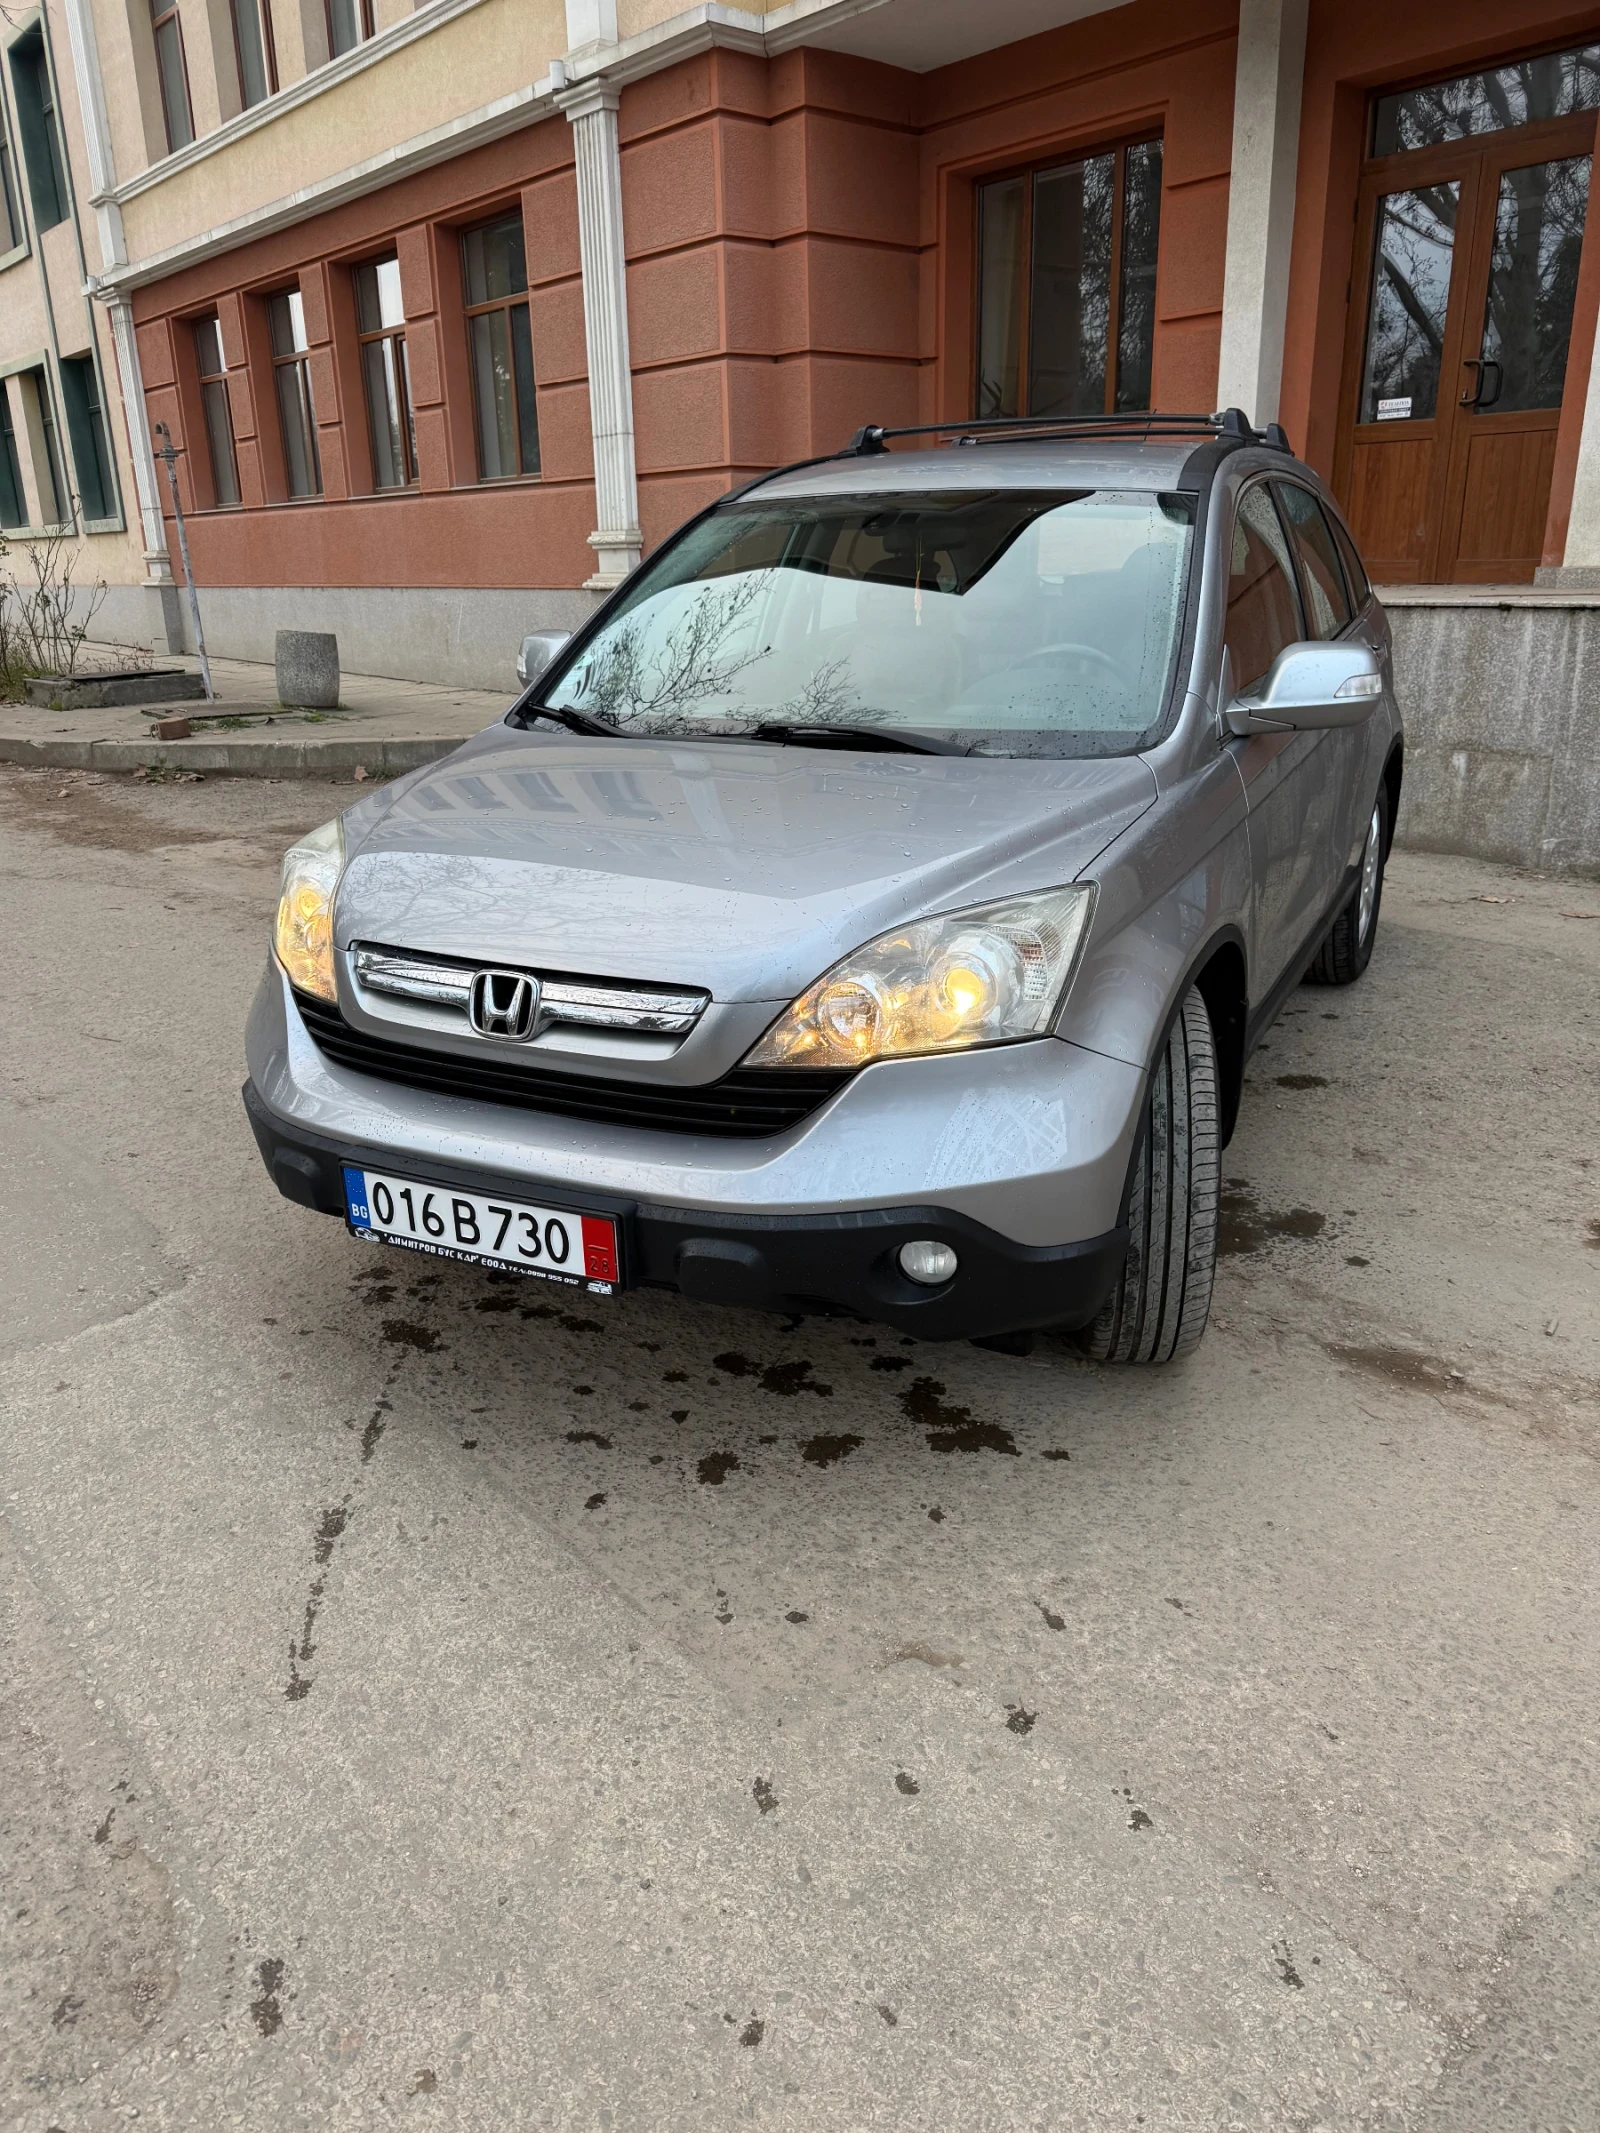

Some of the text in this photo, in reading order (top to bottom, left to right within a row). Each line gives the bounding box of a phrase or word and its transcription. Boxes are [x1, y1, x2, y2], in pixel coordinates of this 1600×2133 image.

[351, 1203, 368, 1219] BG
[437, 1248, 455, 1259] БУС
[481, 1257, 507, 1270] ЕООД
[590, 1255, 609, 1273] 28
